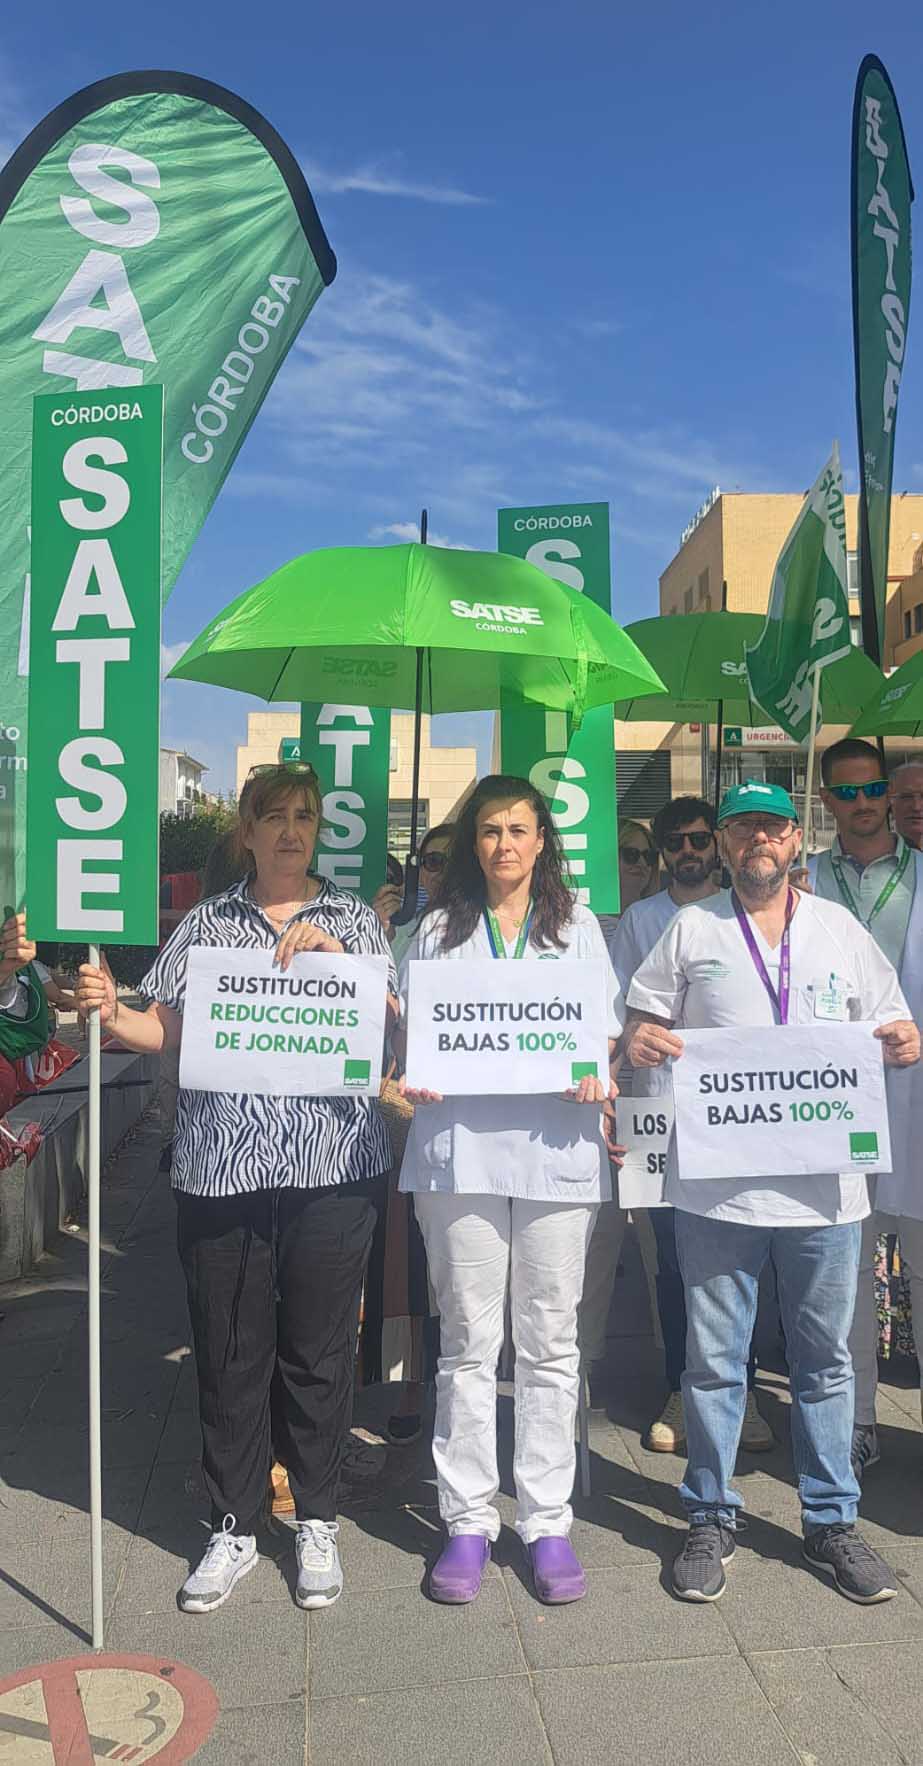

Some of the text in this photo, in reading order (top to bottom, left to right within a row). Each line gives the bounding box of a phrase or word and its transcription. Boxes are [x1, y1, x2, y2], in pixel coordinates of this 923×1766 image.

[865, 95, 904, 433] SATSE
[180, 271, 301, 465] CÓRDOBA
[50, 403, 143, 427] CÓRDOBA
[514, 515, 593, 531] CÓRDOBA
[449, 599, 544, 626] SATSE
[475, 622, 528, 635] CÓRDOBA
[51, 436, 137, 932] SATSE
[217, 975, 356, 999] SUSTITUCIÓN
[210, 1002, 359, 1027] REDUCCIONES
[432, 996, 582, 1022] SUSTITUCIÓN
[215, 1031, 349, 1055] DE JORNADA
[437, 1032, 577, 1052] BAJAS 100%
[699, 1063, 858, 1094] SUSTITUCIÓN
[633, 1114, 667, 1136] LOS
[707, 1100, 854, 1126] BAJAS 100%
